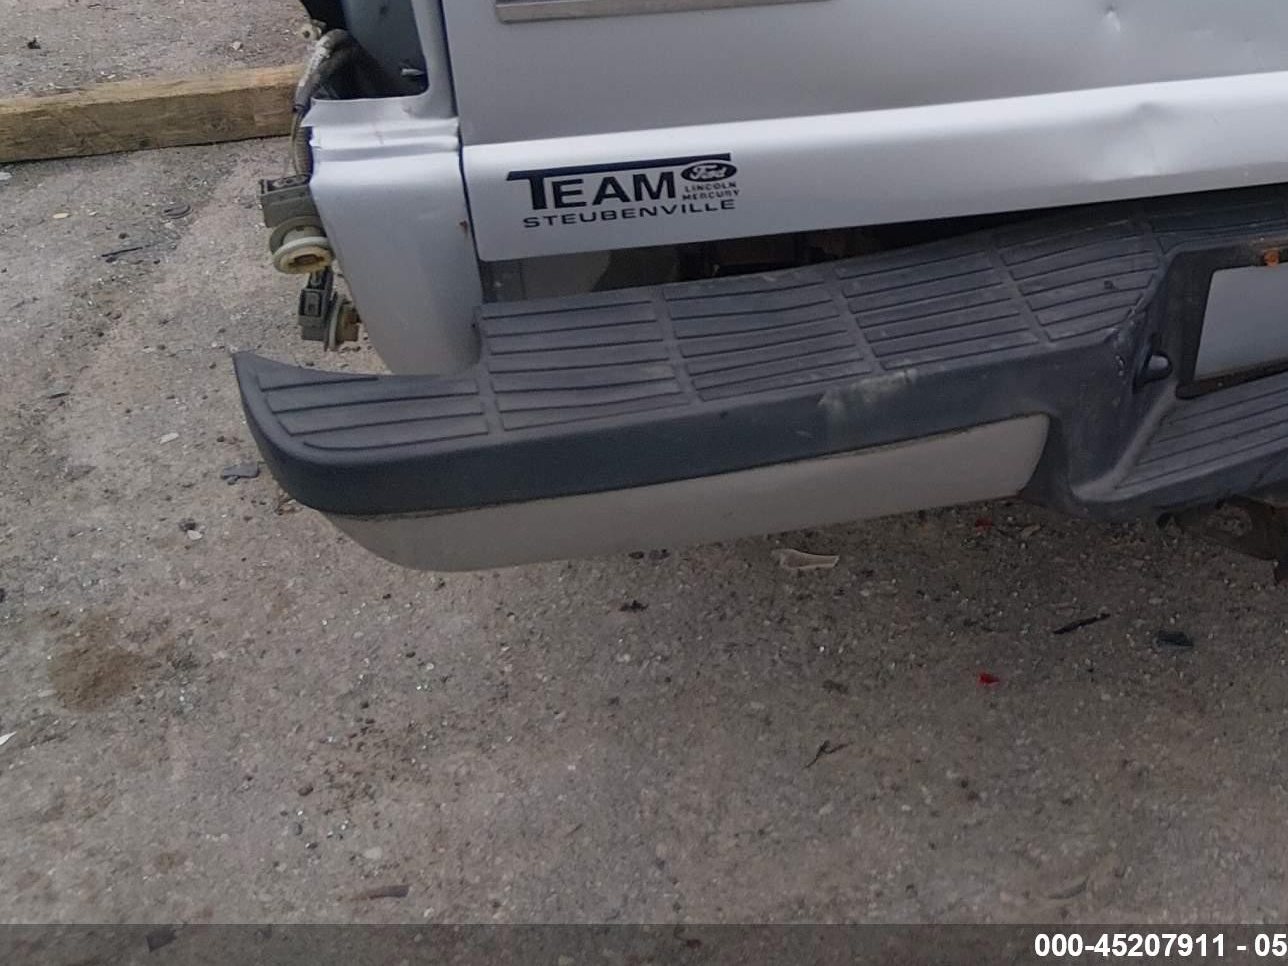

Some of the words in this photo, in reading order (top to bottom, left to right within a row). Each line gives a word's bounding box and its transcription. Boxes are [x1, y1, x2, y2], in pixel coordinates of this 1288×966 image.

[689, 163, 728, 180] Ford
[506, 153, 731, 210] TEAM
[684, 182, 737, 193] LINCOLN
[682, 189, 740, 201] MERCURY
[523, 199, 736, 228] STEUBENVILLE
